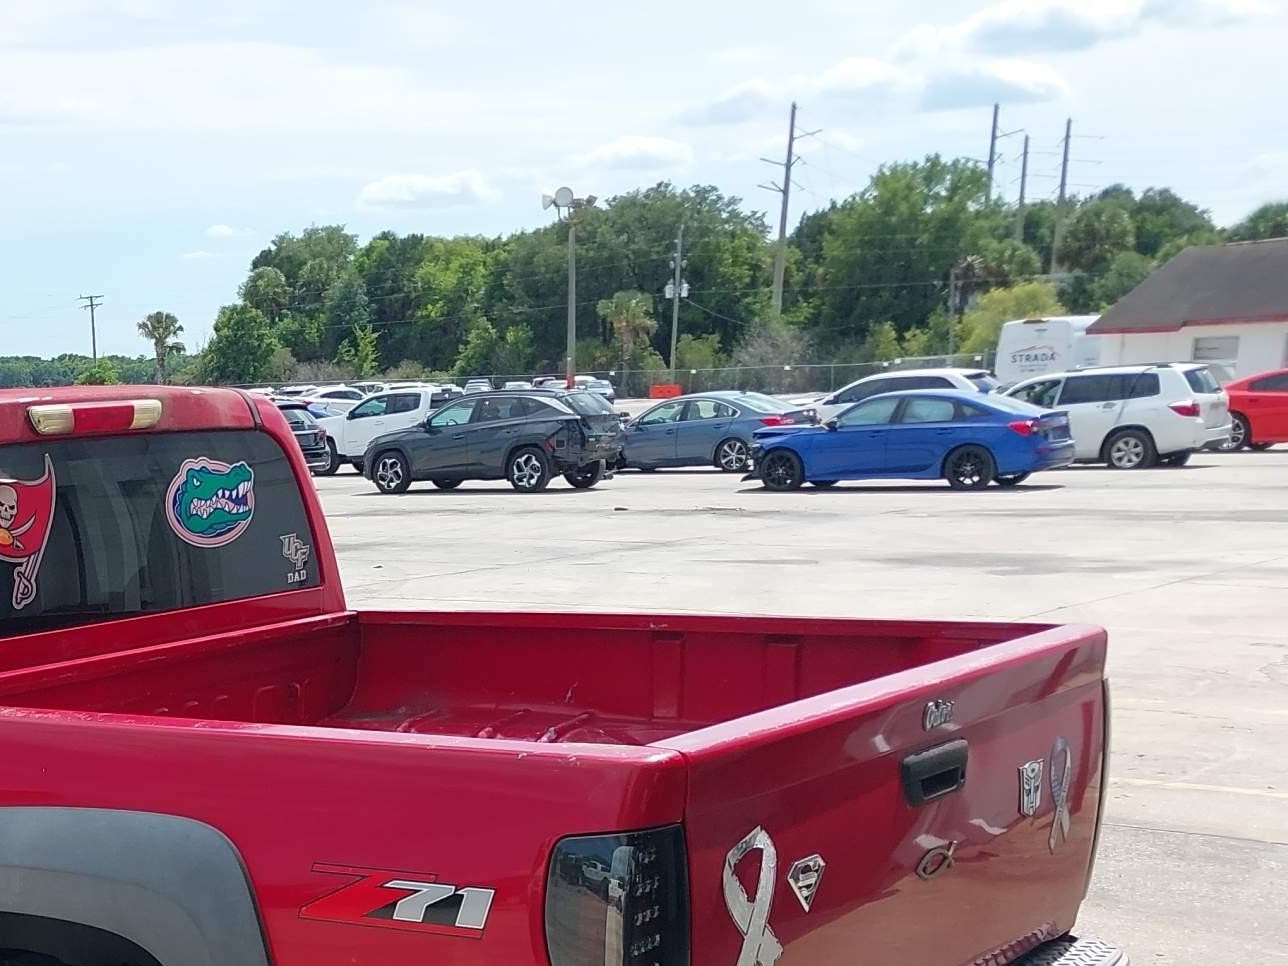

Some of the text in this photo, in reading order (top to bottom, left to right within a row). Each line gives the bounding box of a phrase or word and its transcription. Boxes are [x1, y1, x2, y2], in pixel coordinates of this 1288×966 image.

[1010, 352, 1056, 364] STRADA
[279, 533, 310, 570] UCF
[287, 570, 307, 584] DAD
[297, 862, 498, 940] Z71
